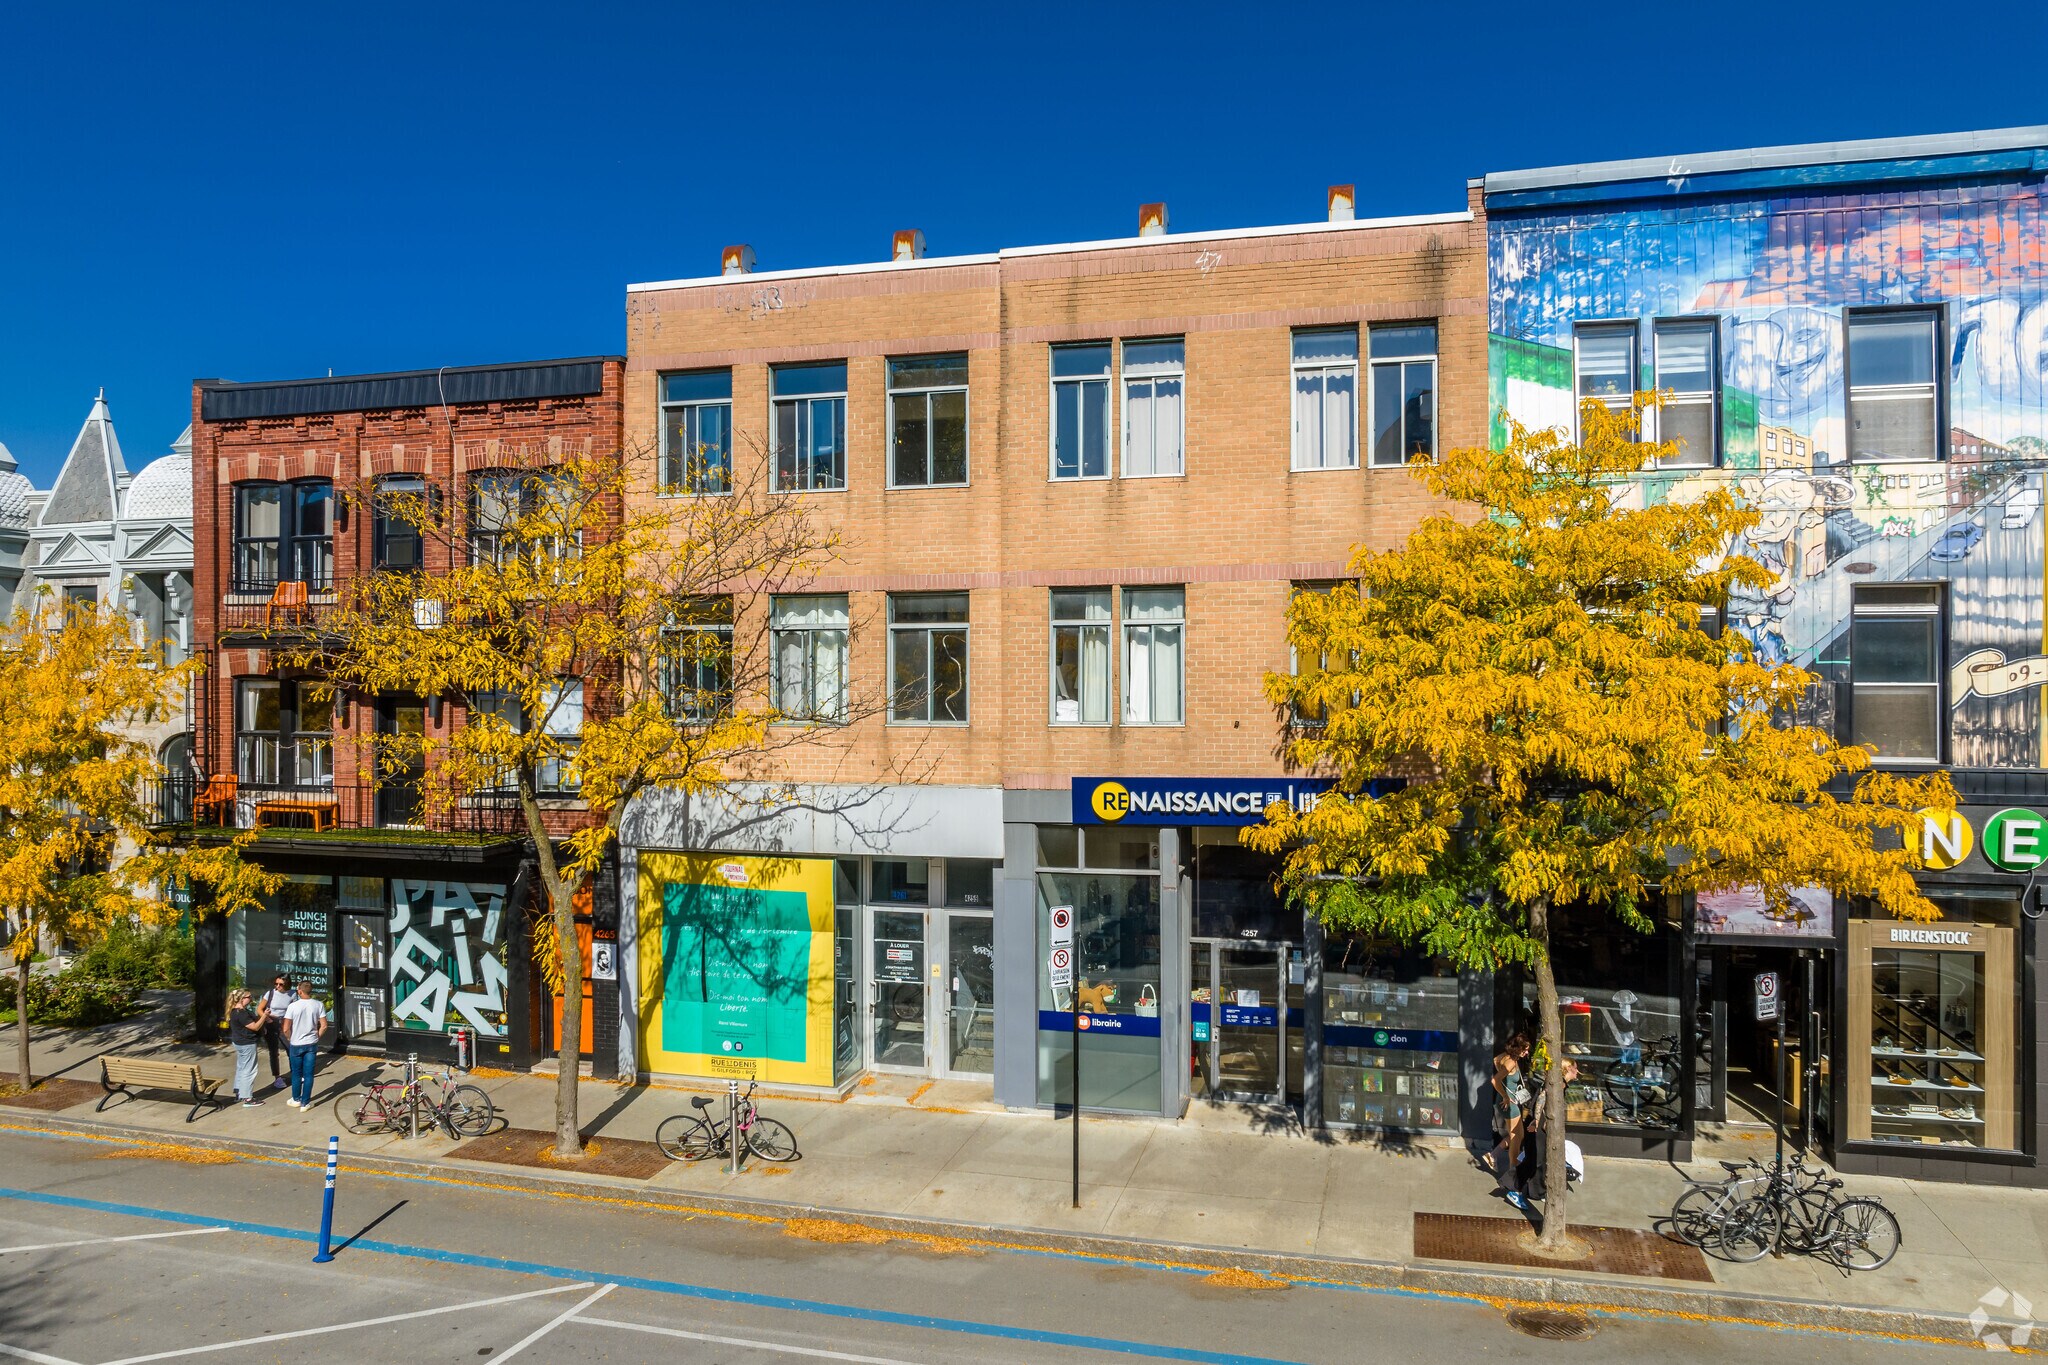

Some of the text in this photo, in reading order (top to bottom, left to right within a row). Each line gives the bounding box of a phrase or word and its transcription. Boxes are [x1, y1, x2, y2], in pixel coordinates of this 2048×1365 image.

[1103, 791, 1263, 813] RENAISSANCE
[294, 910, 327, 922] LUNCH
[288, 920, 327, 931] BRUNCH
[594, 929, 616, 939] 4265
[1240, 929, 1259, 937] 4257
[1890, 928, 1969, 945] BIRKENSTOCK
[295, 965, 328, 976] MAISON
[297, 974, 328, 985] SAISON
[1091, 1018, 1122, 1028] librairie
[1390, 1035, 1408, 1043] don
[711, 1058, 725, 1066] RUE
